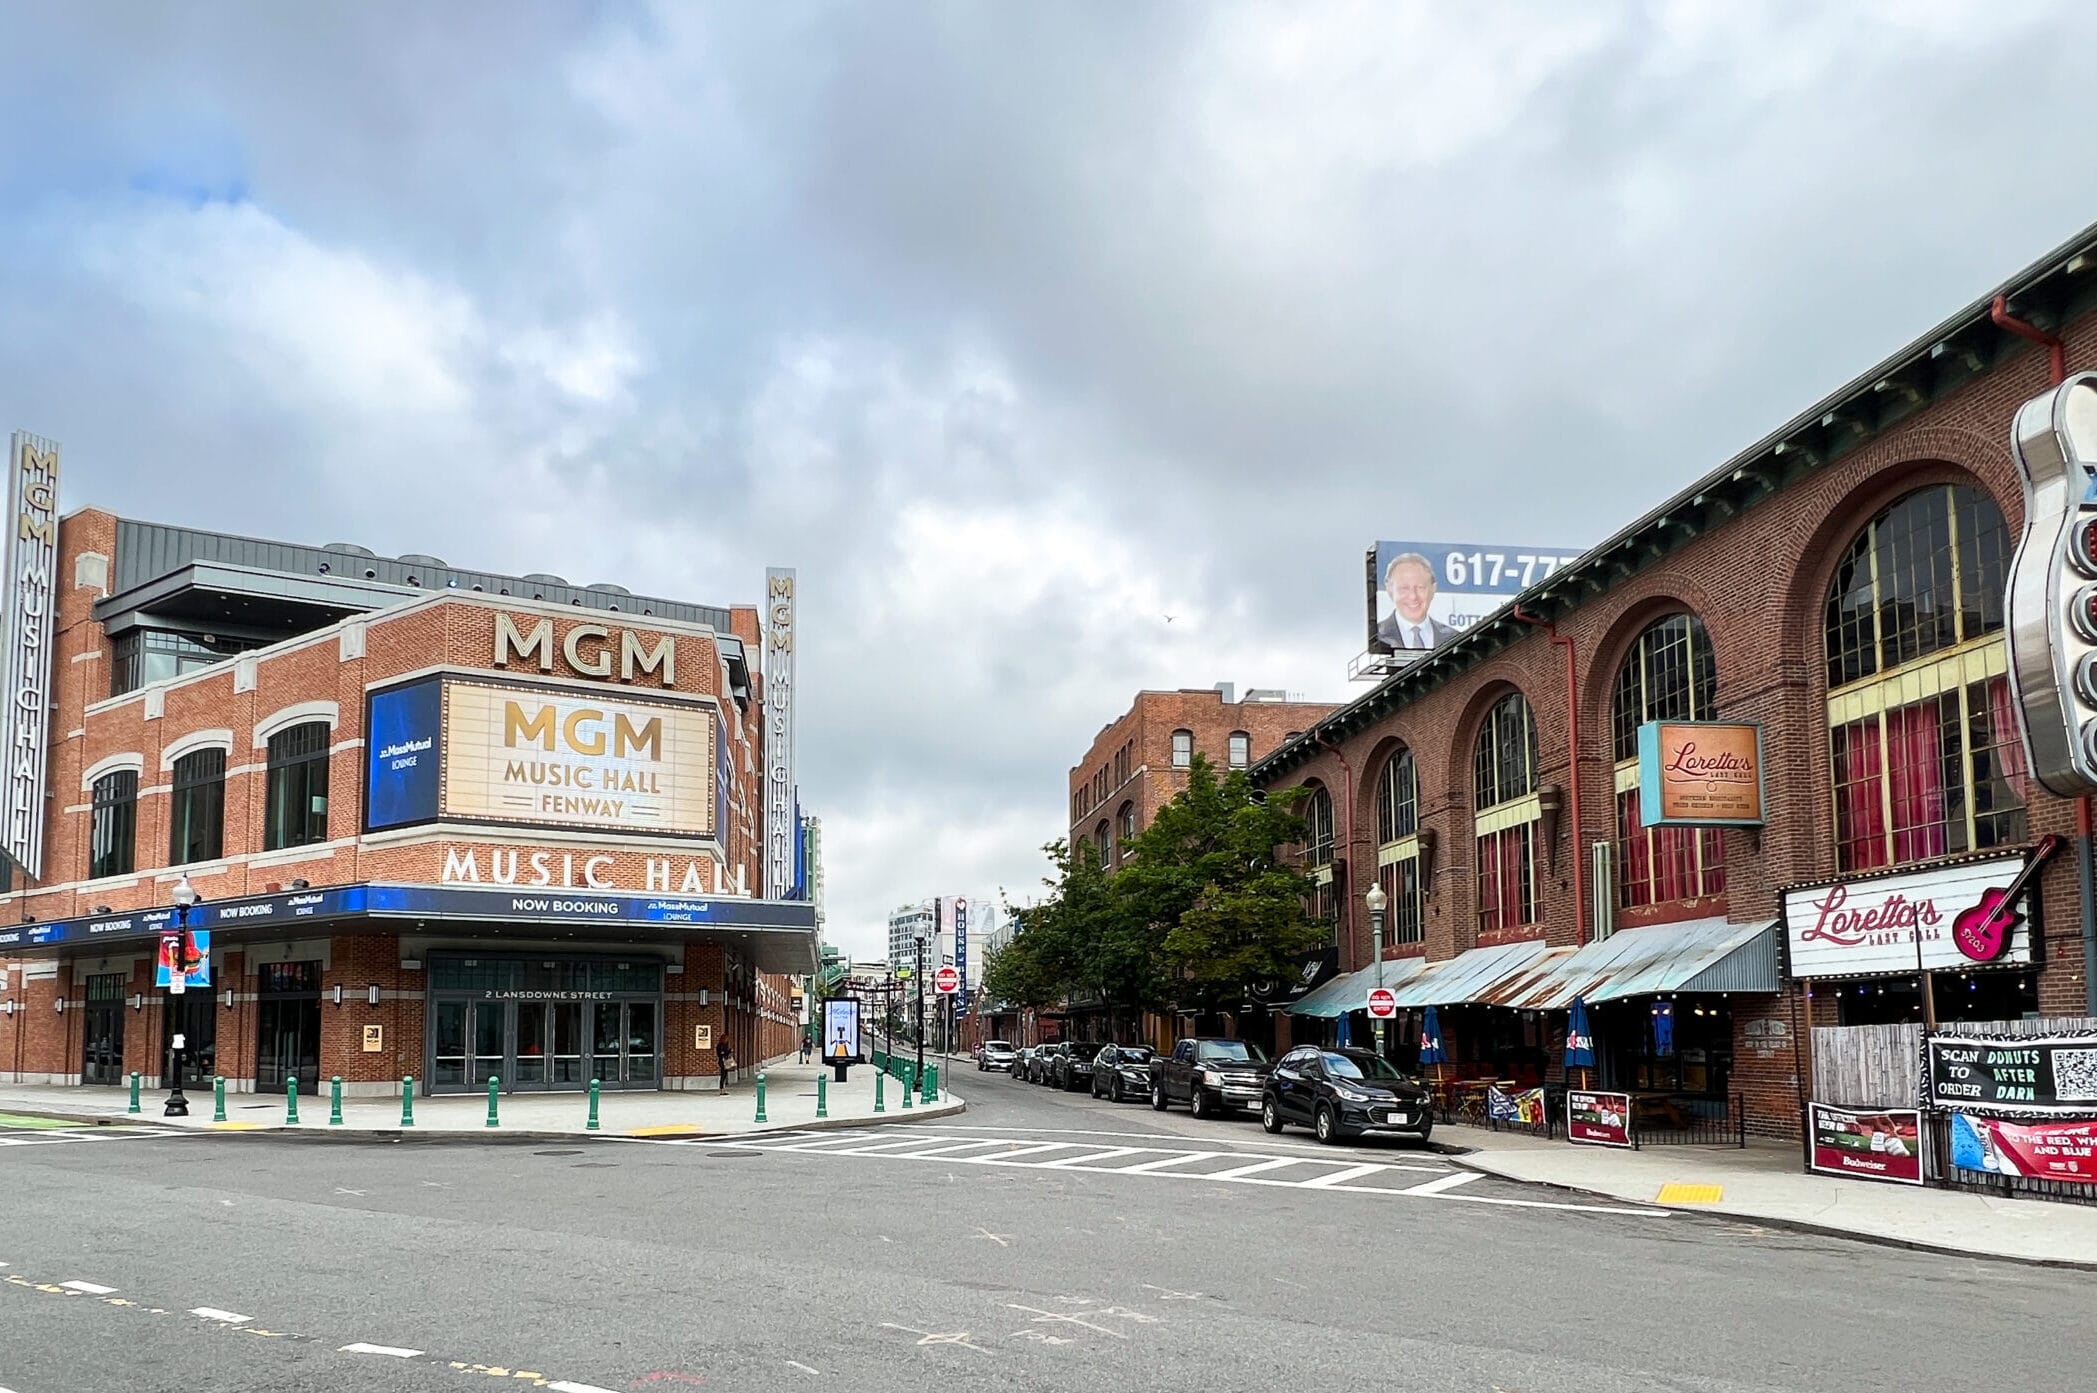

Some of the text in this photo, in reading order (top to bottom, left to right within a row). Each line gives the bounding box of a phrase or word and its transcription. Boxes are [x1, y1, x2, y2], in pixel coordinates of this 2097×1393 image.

[14, 444, 57, 856] MGM MUSIC HALL
[493, 612, 676, 687] MGM
[503, 700, 662, 762] MGM
[769, 575, 795, 892] MGM MUSIC HALL
[387, 739, 432, 756] MassMutual
[391, 756, 418, 771] LOUNGE
[1664, 742, 1753, 777] Loretta's
[503, 760, 661, 795] MUSIC HALL
[542, 794, 623, 818] FENWAY
[441, 847, 752, 897] MUSIC HALL
[220, 904, 274, 919] NOW BOOKING
[512, 899, 619, 914] NOW BOOKING
[658, 902, 708, 912] MassMutual
[662, 913, 693, 921] LOUNGE
[1800, 884, 1943, 946] Loretta's
[1868, 929, 1942, 946] LAST CALL
[485, 990, 613, 1000] 2 LANSDOWNE STREET
[1940, 1049, 1980, 1063] SCAN
[1986, 1049, 2041, 1065] DONUTS
[1948, 1066, 1971, 1079] TO
[1993, 1068, 2036, 1083] AFTER
[1938, 1082, 1982, 1097] ORDER
[2021, 1135, 2044, 1144] THE
[2046, 1136, 2073, 1147] RED,
[2033, 1146, 2092, 1157] AND BLUE
[1843, 1156, 1887, 1171] Budweiser
